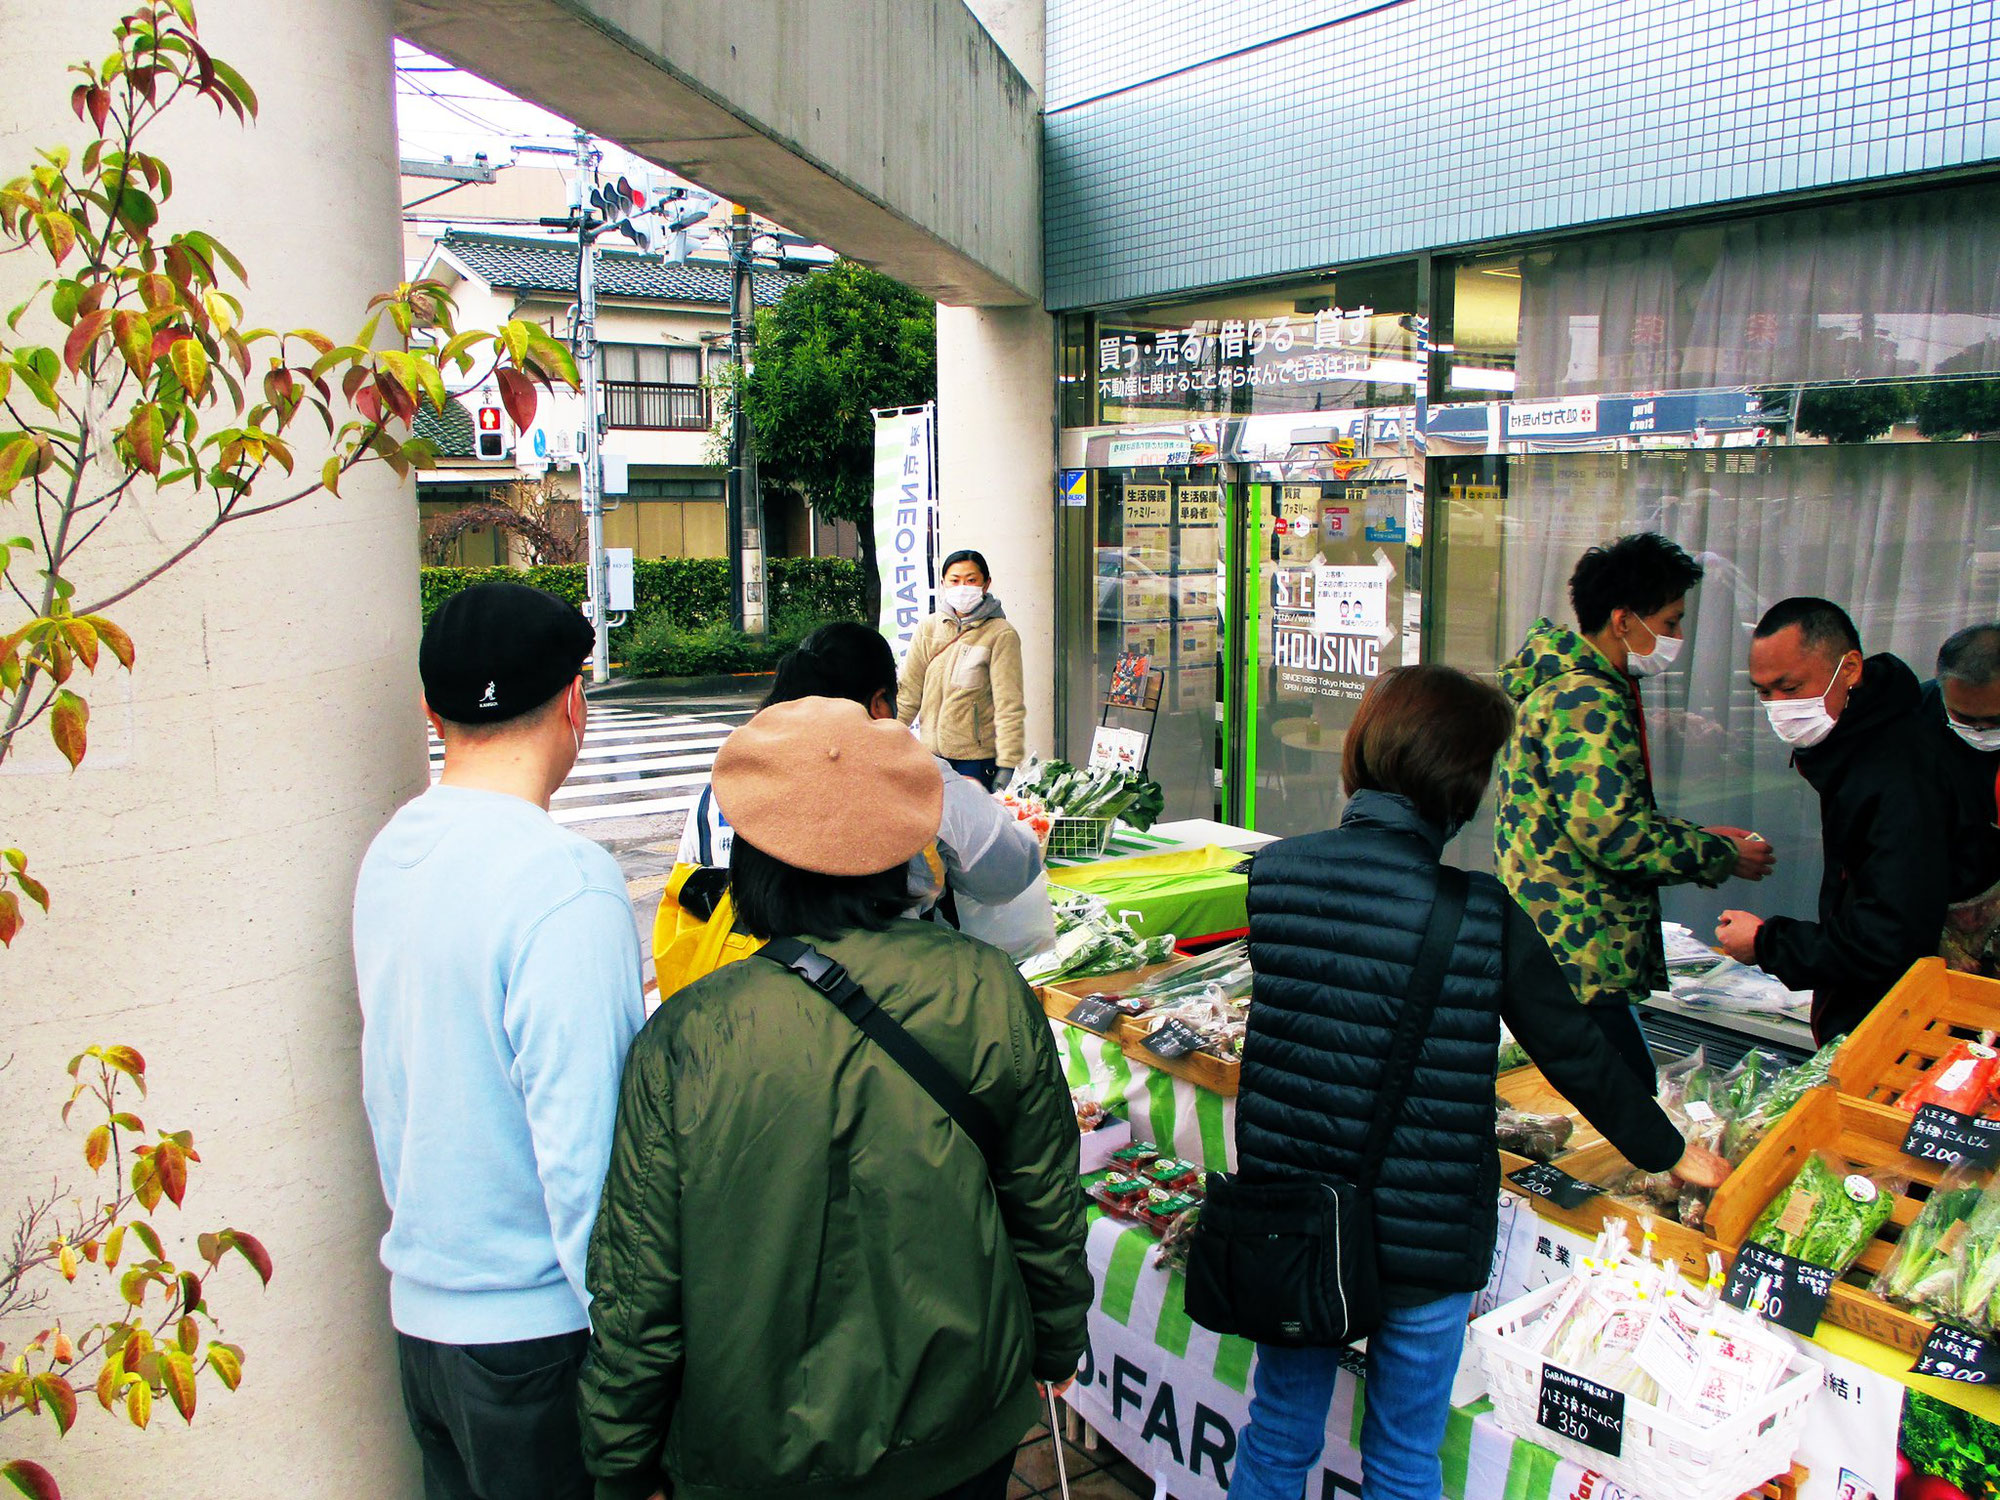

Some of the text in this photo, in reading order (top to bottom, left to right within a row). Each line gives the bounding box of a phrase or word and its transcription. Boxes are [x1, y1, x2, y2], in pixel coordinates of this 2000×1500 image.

[1099, 306, 1374, 373] 買う・売る・借りる・貸す
[1127, 489, 1167, 503] 生活保護
[1275, 631, 1380, 677] HOUSING
[1318, 677, 1338, 688] Tokyo
[1339, 680, 1366, 692] Hachioji
[1912, 1118, 1991, 1149] 有機にんじん
[1921, 1142, 1961, 1163] 200
[1520, 1179, 1552, 1196] 200
[1536, 1235, 1570, 1269] 農業
[1928, 1338, 1977, 1363] 小松菜
[1932, 1361, 1986, 1383] 200
[1557, 1410, 1589, 1440] 350
